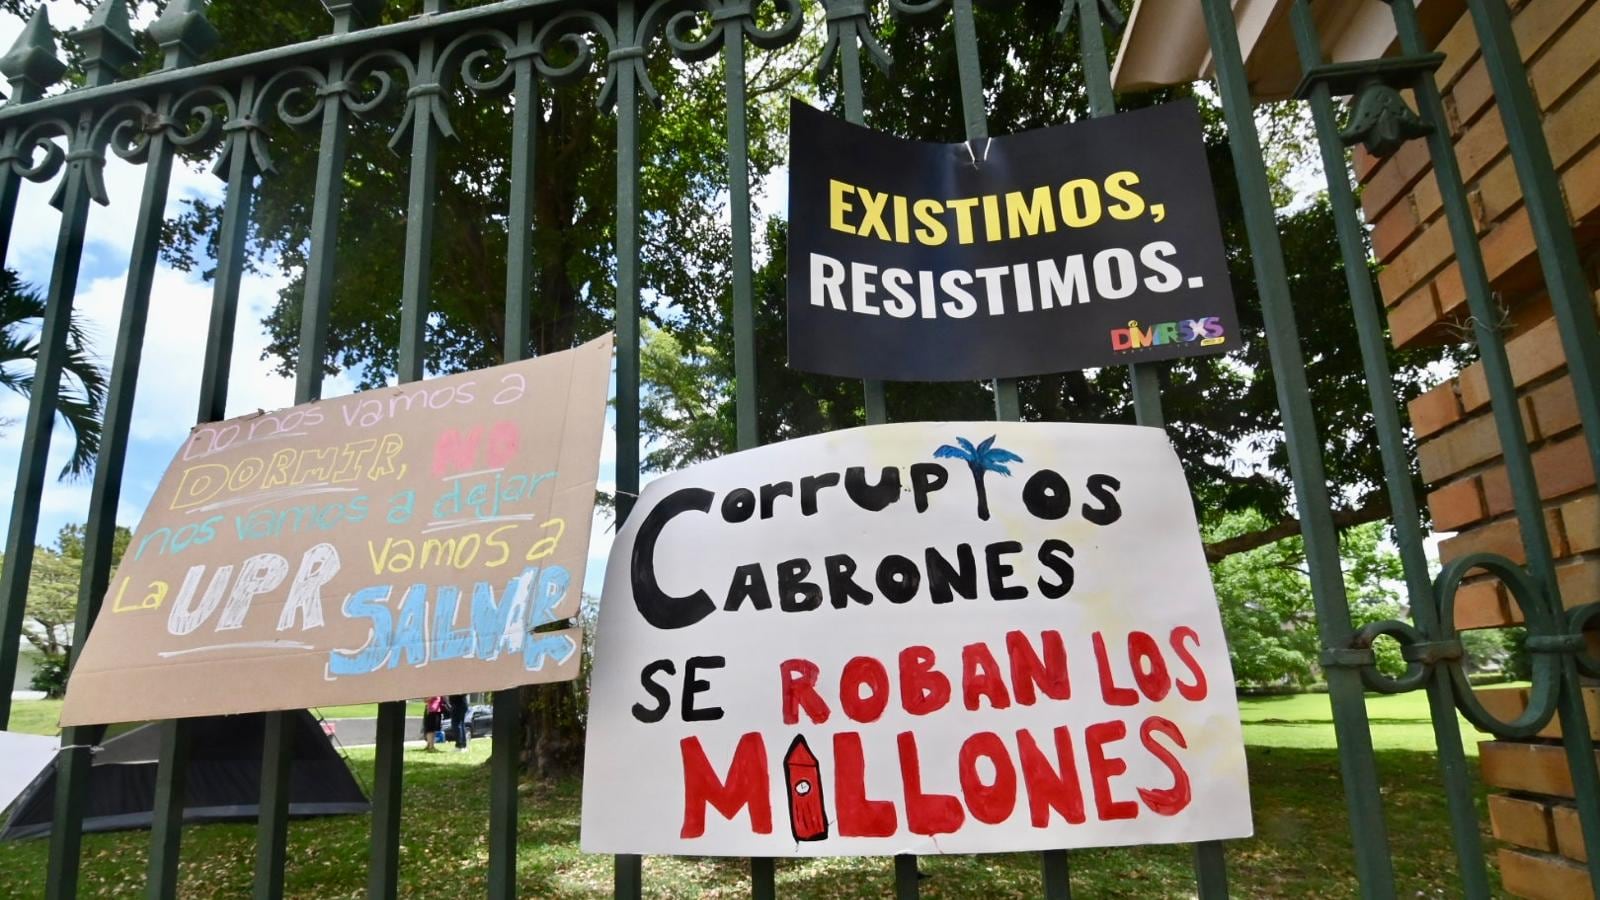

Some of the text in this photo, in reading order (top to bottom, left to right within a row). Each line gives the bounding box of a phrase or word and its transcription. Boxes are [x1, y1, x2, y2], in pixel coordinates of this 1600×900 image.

[829, 171, 1166, 246] EXISTIMOS,
[809, 241, 1204, 319] RESISTIMOS.
[248, 406, 325, 441] nos
[342, 381, 477, 427] vamos
[492, 373, 527, 406] a
[170, 420, 521, 510] DORMIR, NO
[134, 470, 560, 561] nos vamos a dejar
[112, 518, 567, 636] La UPR vamos a
[323, 564, 577, 681] SALVAR
[631, 626, 1208, 725] SE ROBAN LOS
